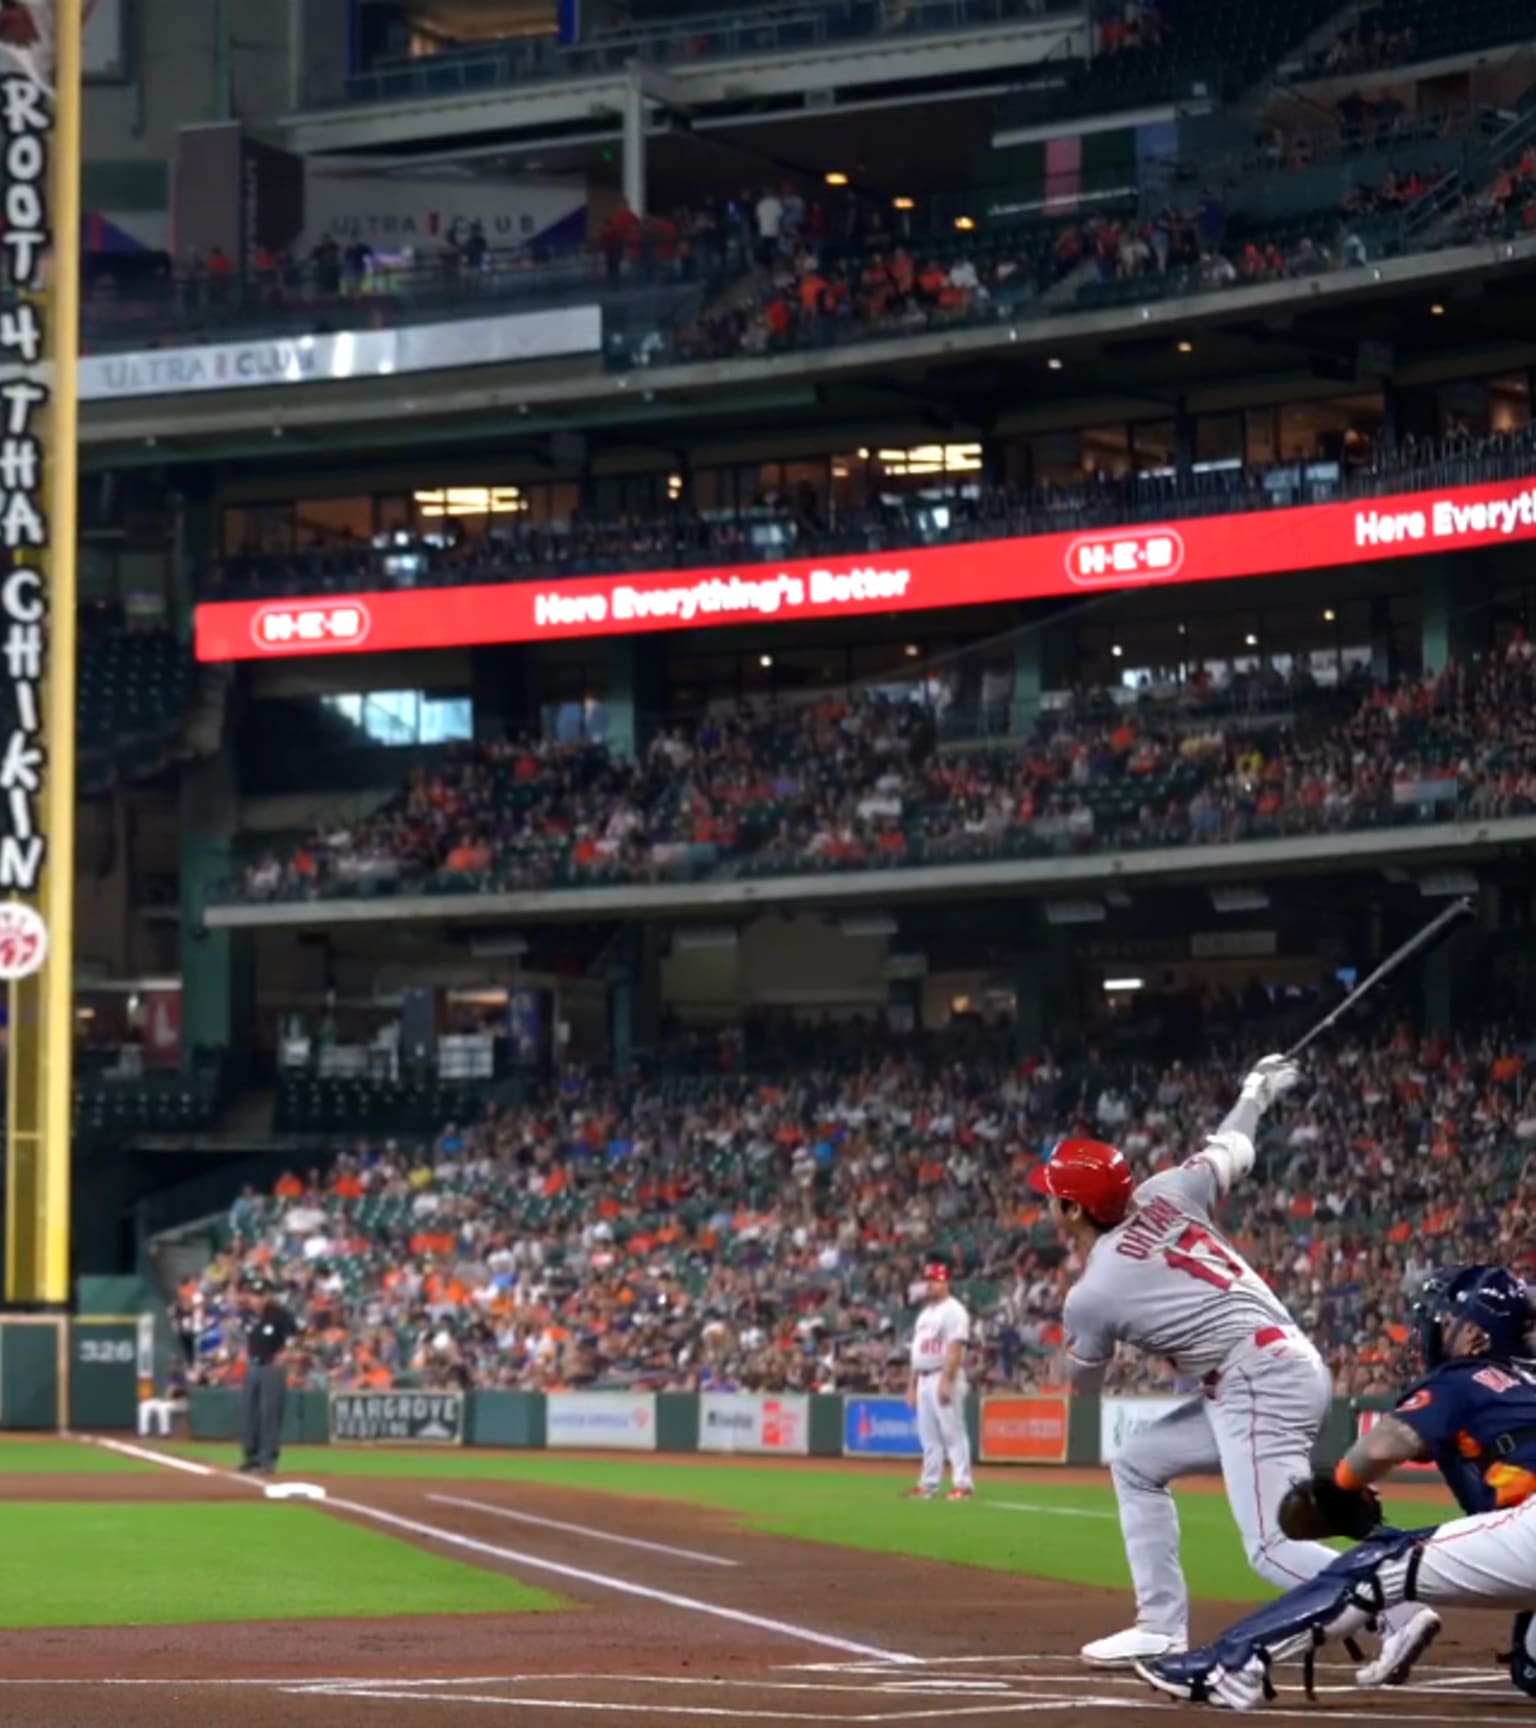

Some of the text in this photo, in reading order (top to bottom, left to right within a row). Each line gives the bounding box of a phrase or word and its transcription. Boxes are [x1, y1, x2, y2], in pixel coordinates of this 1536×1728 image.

[0, 78, 50, 282] ROOT
[332, 213, 417, 238] ULTRA
[0, 304, 38, 360] 4
[98, 355, 207, 388] ULTRA
[1355, 511, 1426, 547] Here
[534, 567, 911, 626] Here Everything's Better
[78, 1339, 134, 1363] 326
[335, 1396, 460, 1421] HARGROVE
